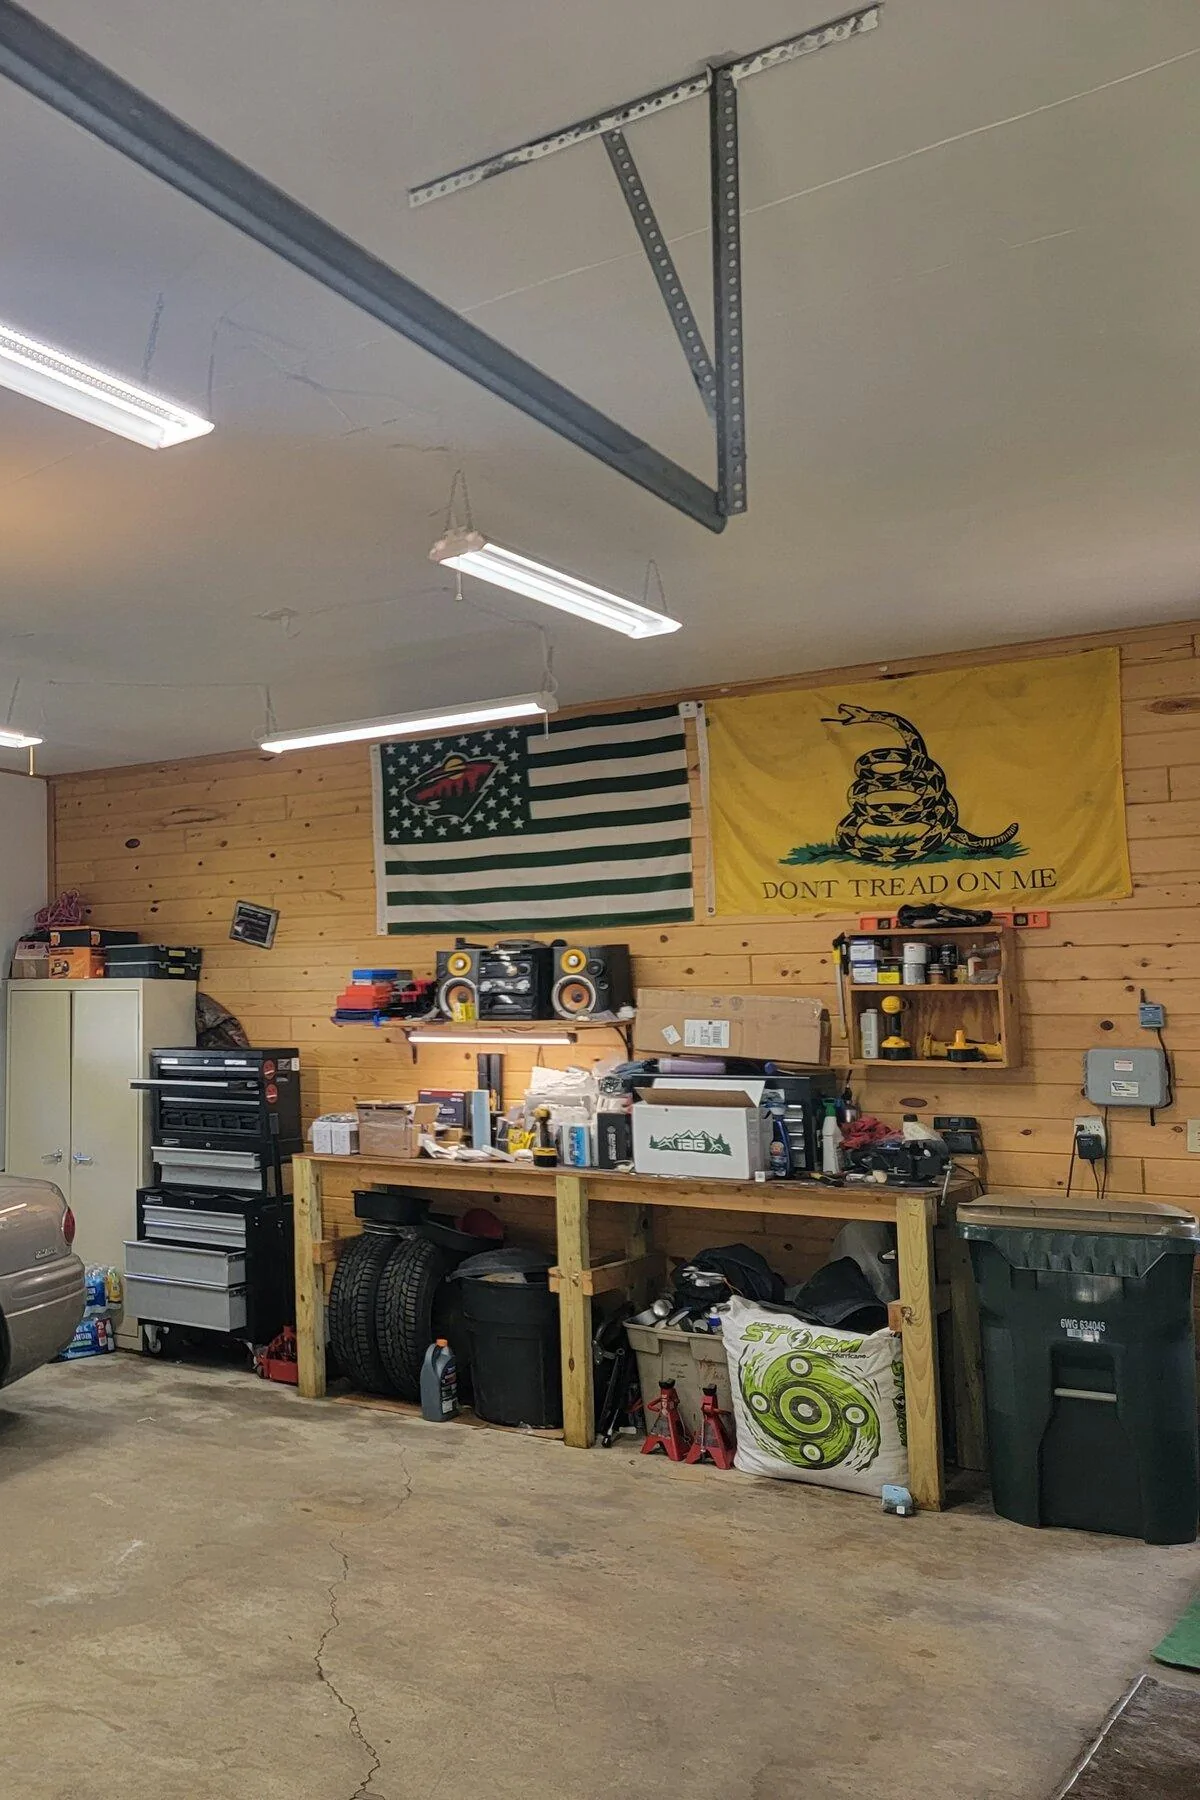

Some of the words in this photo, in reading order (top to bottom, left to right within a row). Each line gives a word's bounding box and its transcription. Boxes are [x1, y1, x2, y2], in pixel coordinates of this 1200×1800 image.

[761, 879, 840, 899] DONT
[848, 873, 949, 898] TREAD
[956, 870, 1003, 893] ON
[1010, 867, 1058, 890] ME
[739, 1324, 864, 1353] STORM
